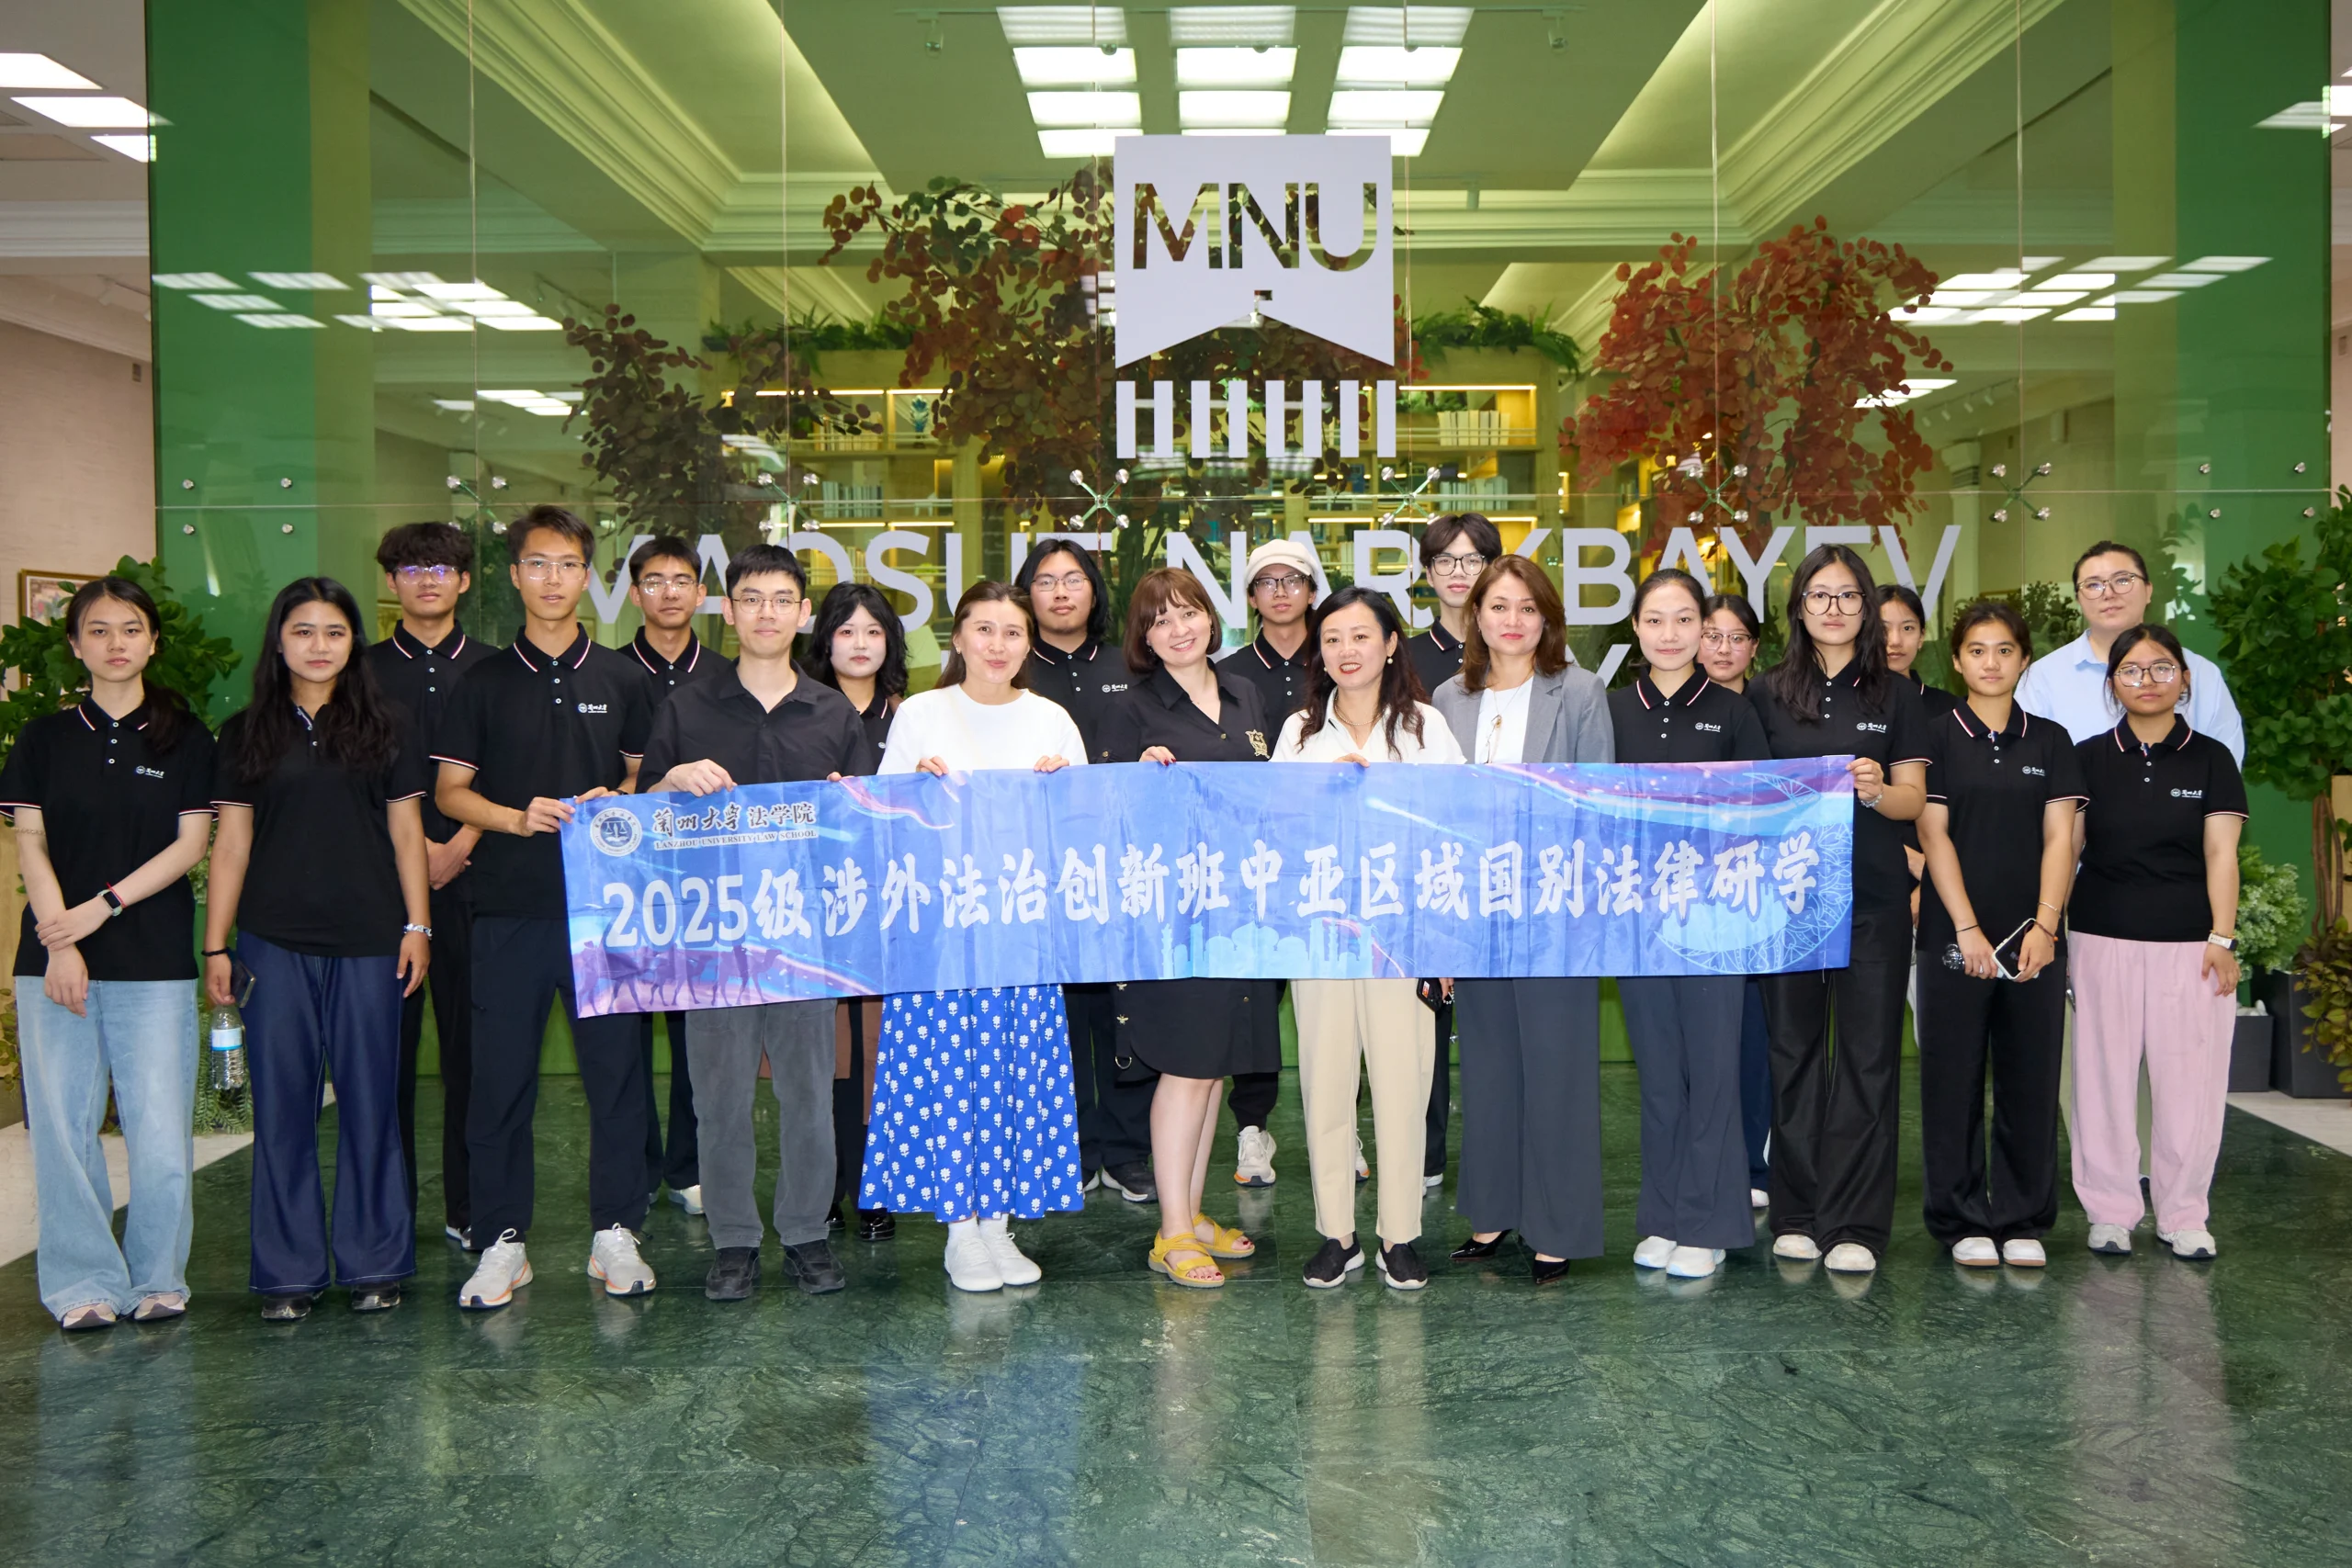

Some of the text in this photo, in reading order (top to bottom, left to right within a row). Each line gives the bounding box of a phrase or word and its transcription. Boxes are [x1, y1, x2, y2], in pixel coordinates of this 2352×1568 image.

[1133, 183, 1377, 272] MNU
[656, 829, 817, 850] LANZHOU UNIVERSITY LAW SCHOOL
[603, 830, 1820, 948] 2025级涉外法治创新班中亚区域国别法律研学
